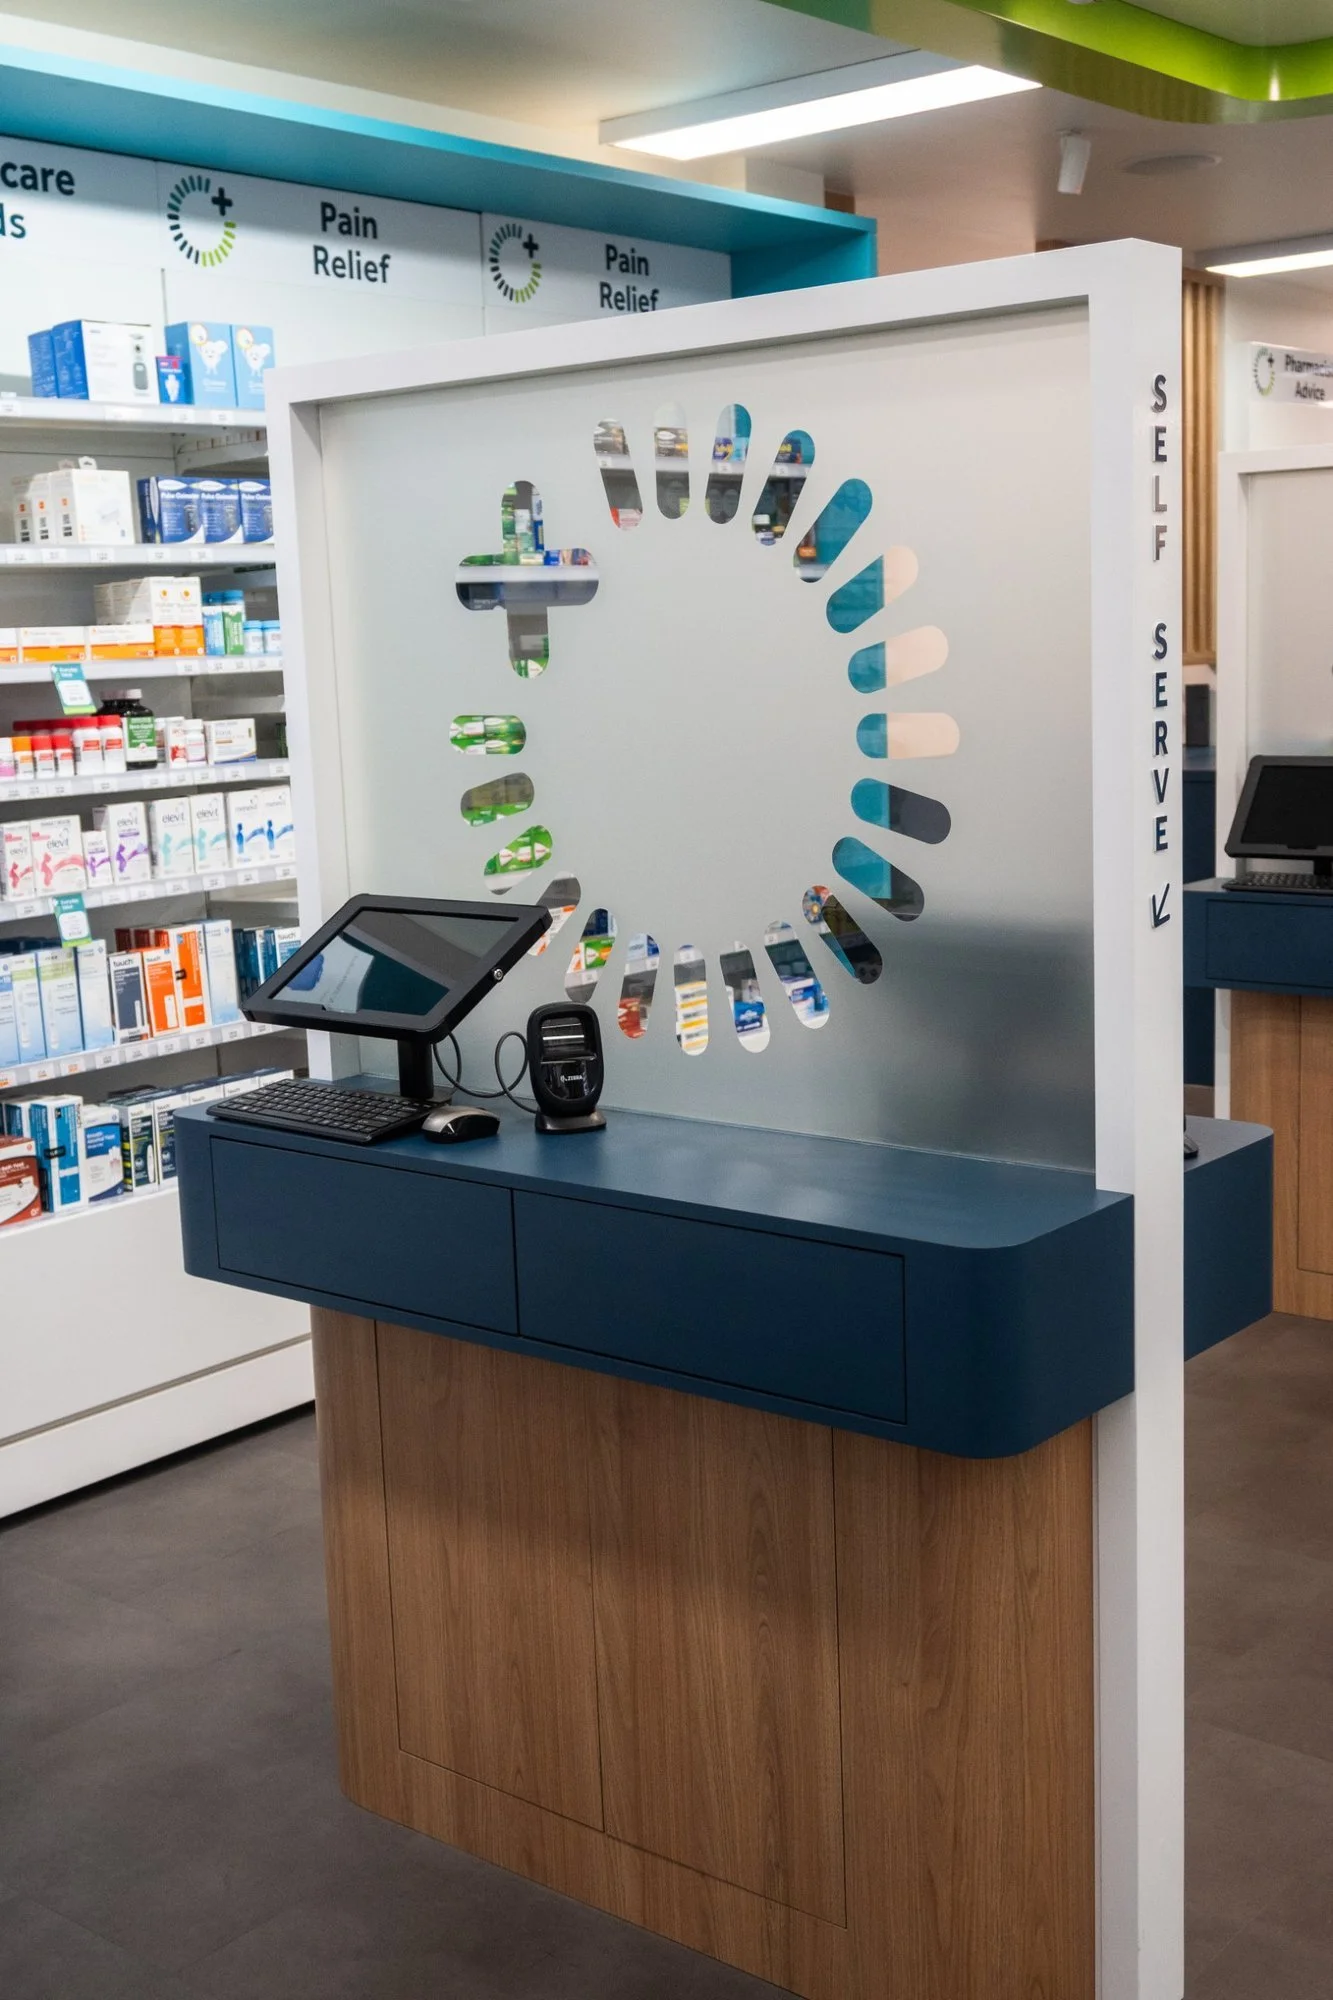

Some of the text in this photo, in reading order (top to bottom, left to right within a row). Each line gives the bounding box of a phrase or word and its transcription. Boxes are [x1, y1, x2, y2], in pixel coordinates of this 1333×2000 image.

[0, 161, 76, 196] care
[320, 201, 378, 239] Pain
[313, 244, 391, 283] Relief
[605, 243, 649, 276] Pain
[599, 281, 660, 312] Relief
[1295, 380, 1326, 401] Advice
[1151, 374, 1170, 852] SELF SERVE
